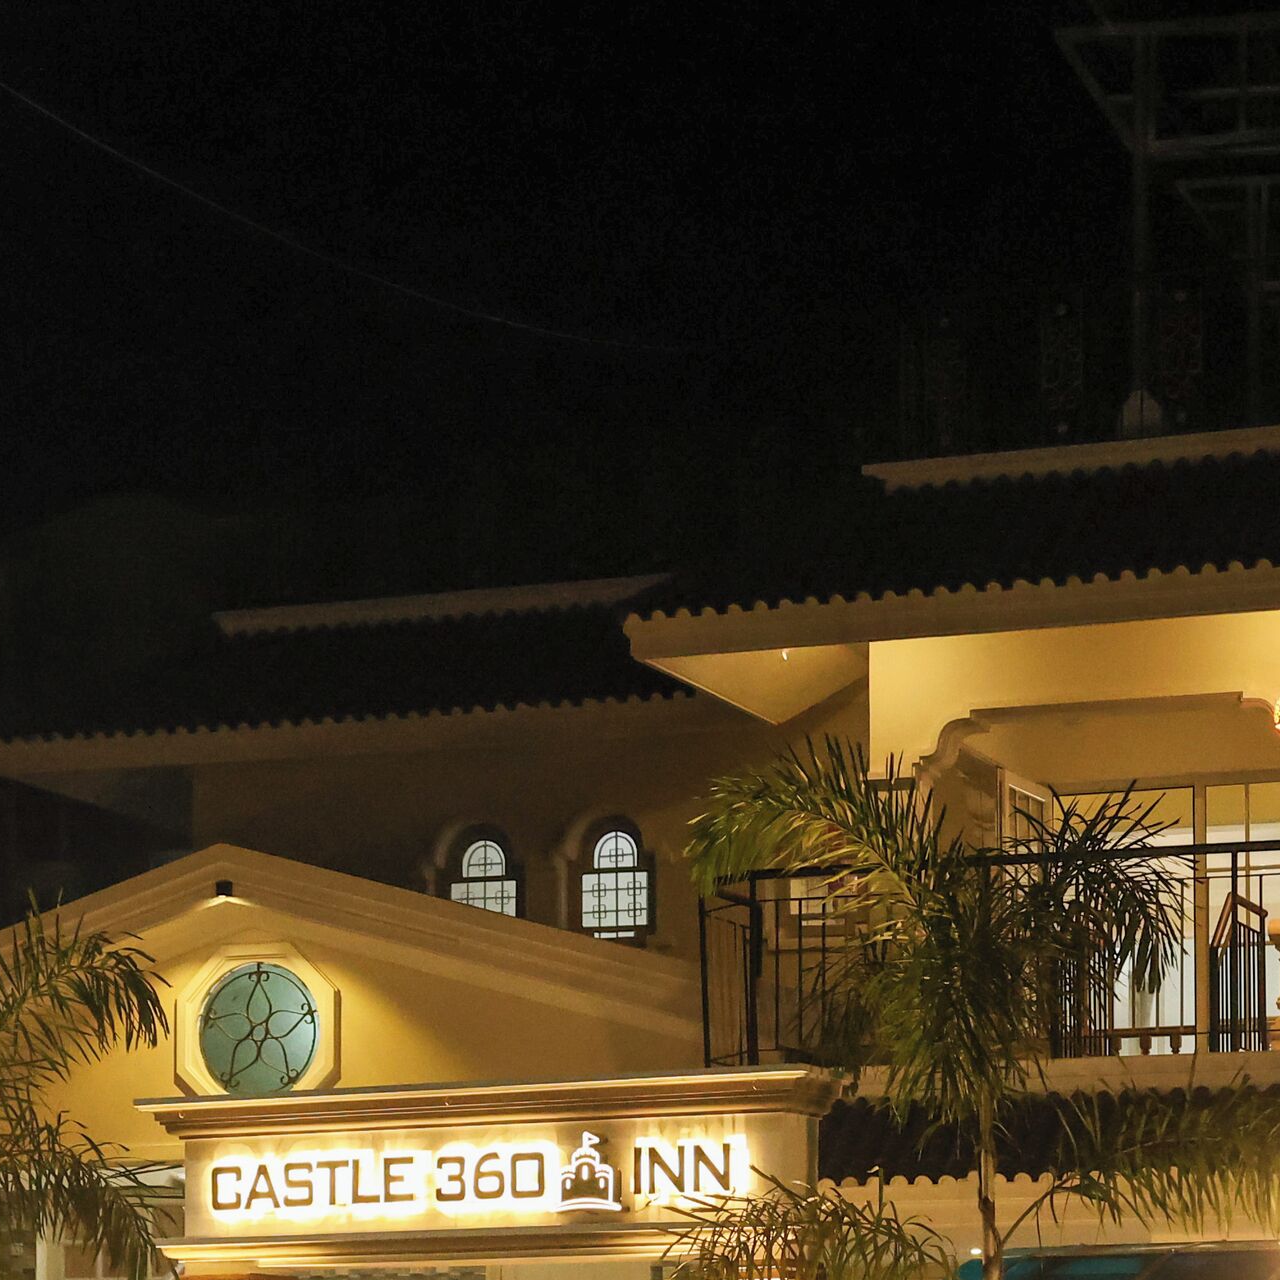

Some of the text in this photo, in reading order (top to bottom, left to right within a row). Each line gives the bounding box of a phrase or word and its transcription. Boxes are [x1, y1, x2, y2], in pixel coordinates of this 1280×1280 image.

[211, 1143, 731, 1211] CASTLE 360 INN
